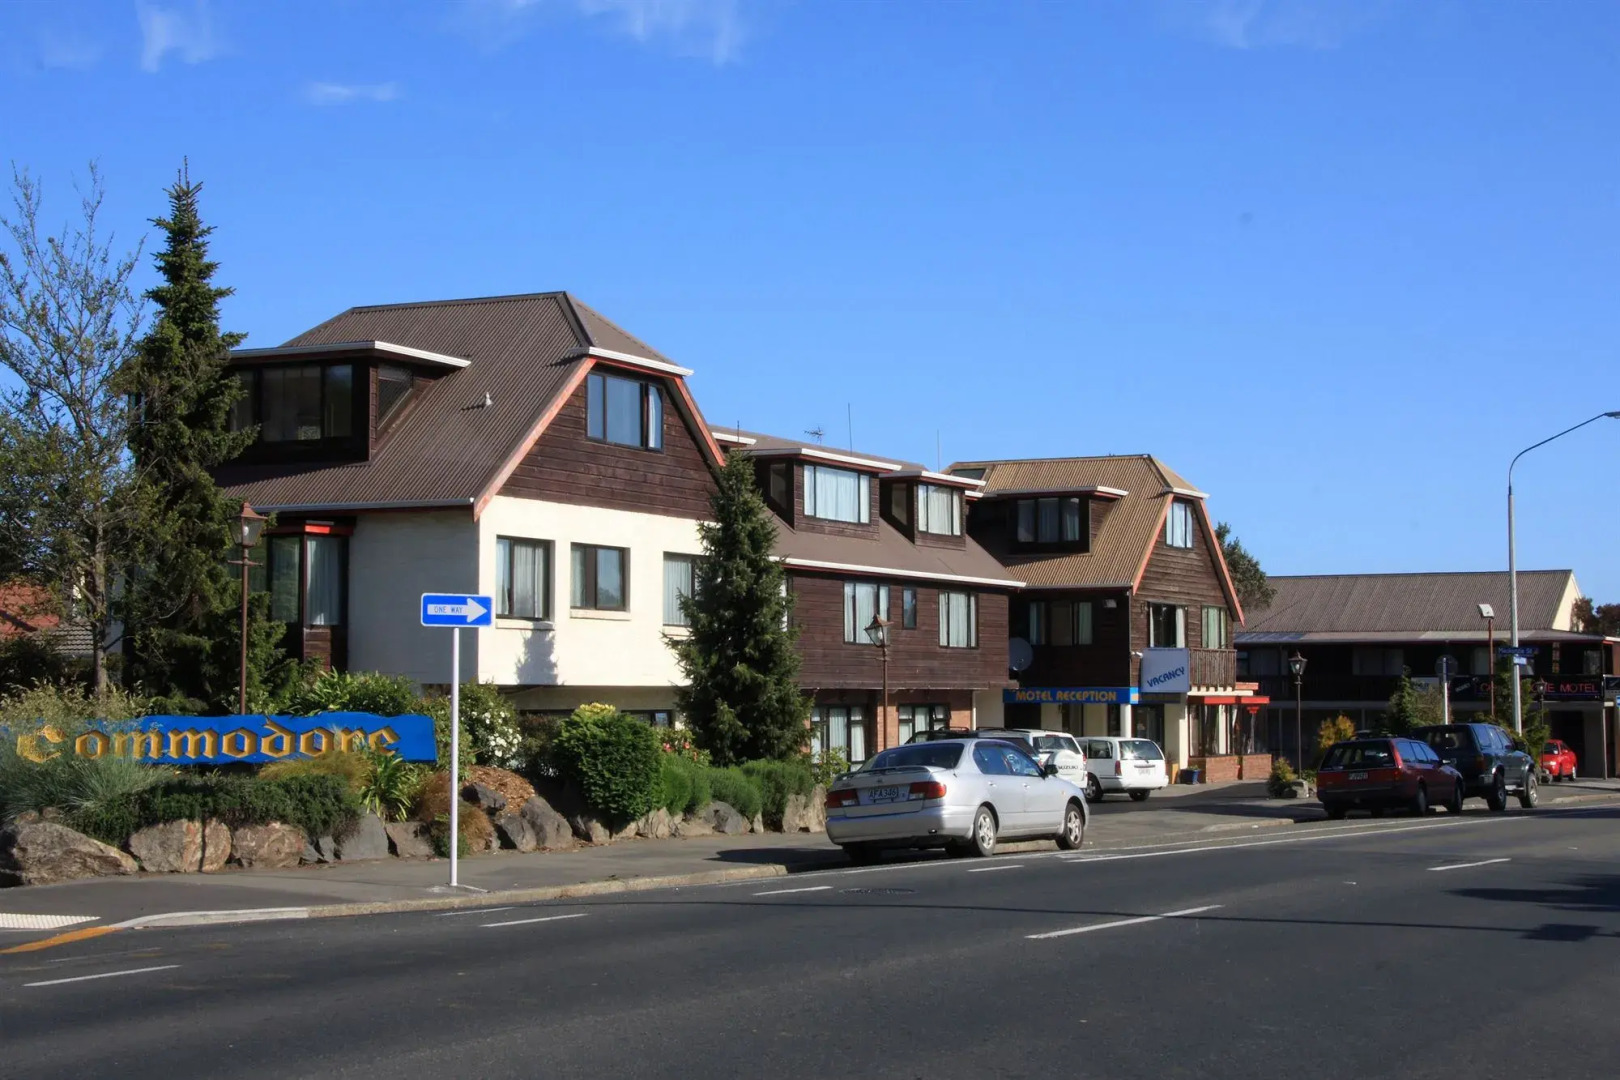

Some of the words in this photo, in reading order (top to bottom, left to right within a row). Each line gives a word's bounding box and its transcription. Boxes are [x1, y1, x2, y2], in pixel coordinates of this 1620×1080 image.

[1147, 666, 1185, 688] VACANCY
[1016, 690, 1053, 701] MOTEL
[1056, 690, 1117, 701] RECEPTION
[1559, 682, 1599, 693] MOTEL
[16, 715, 400, 763] Commodore
